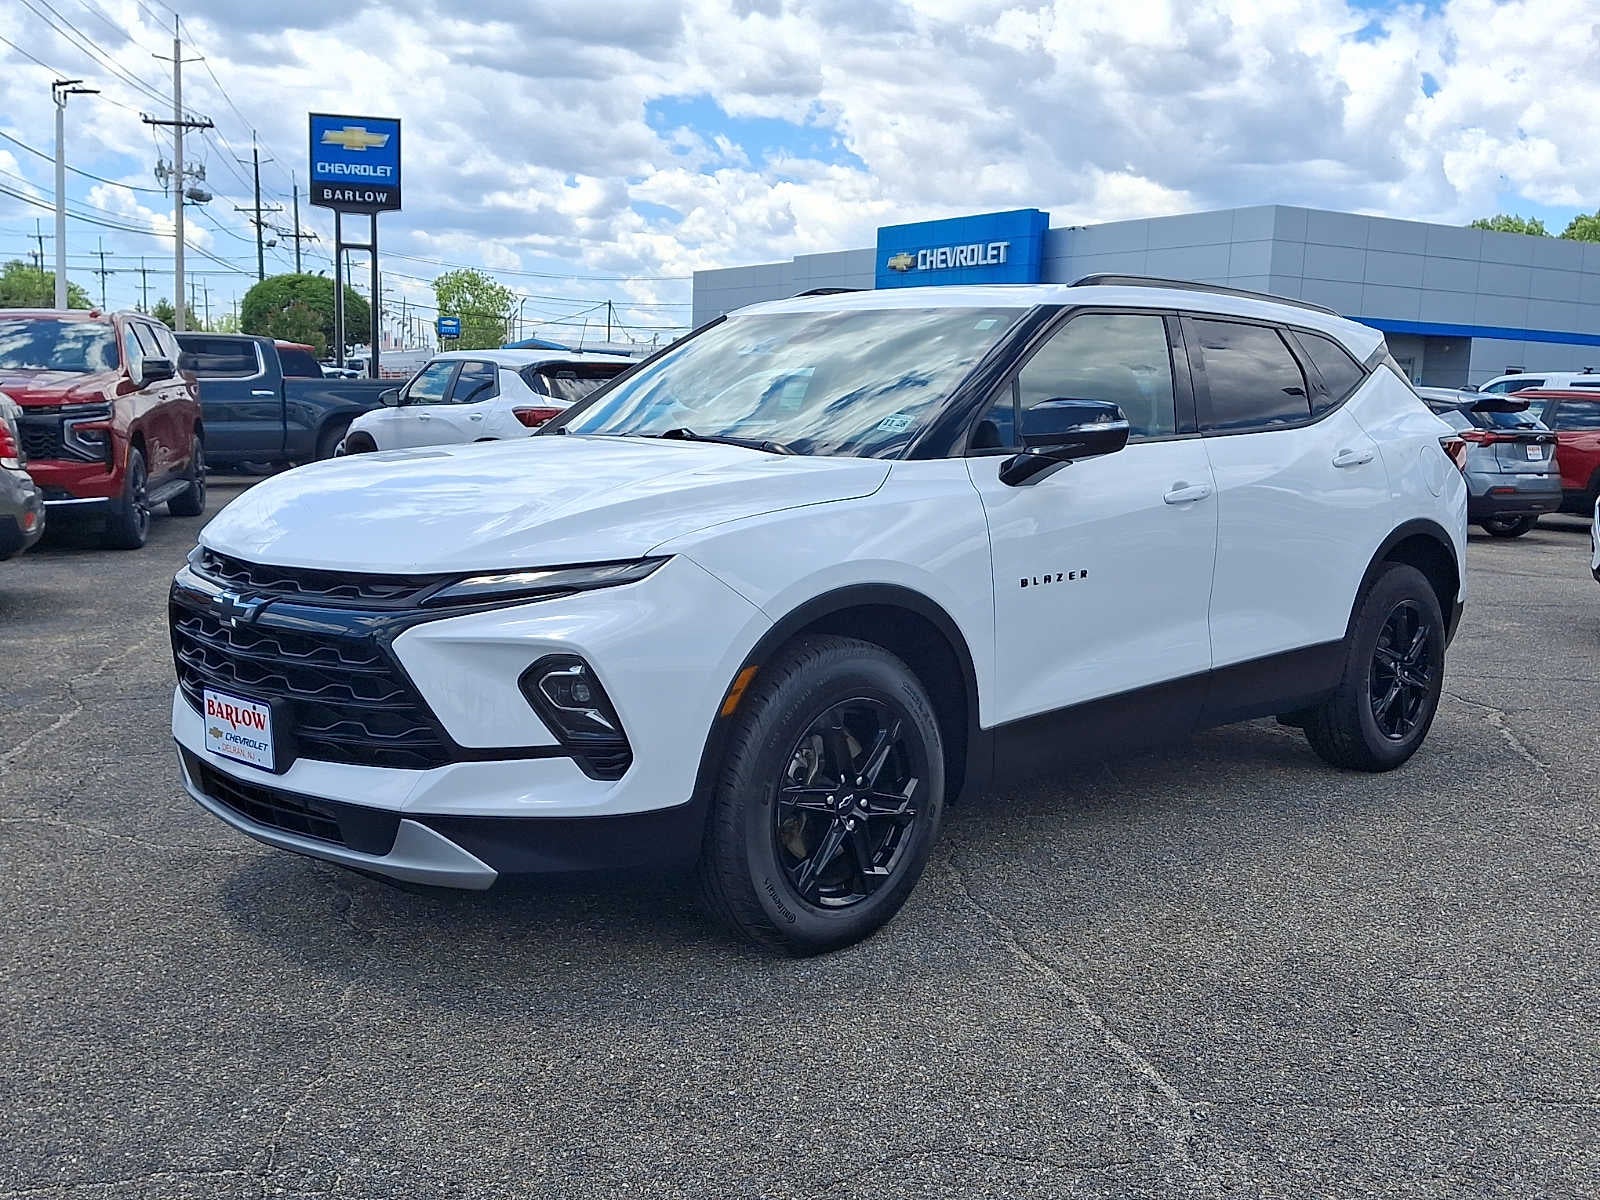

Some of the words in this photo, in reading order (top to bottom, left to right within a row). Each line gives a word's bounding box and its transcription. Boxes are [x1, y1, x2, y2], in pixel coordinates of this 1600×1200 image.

[317, 162, 393, 177] CHEVROLET
[323, 188, 388, 203] BARLOW
[917, 241, 1010, 270] CHEVROLET
[1020, 569, 1088, 588] BLAZER
[207, 699, 266, 730] BARLOW
[225, 732, 268, 751] CHEVROLET
